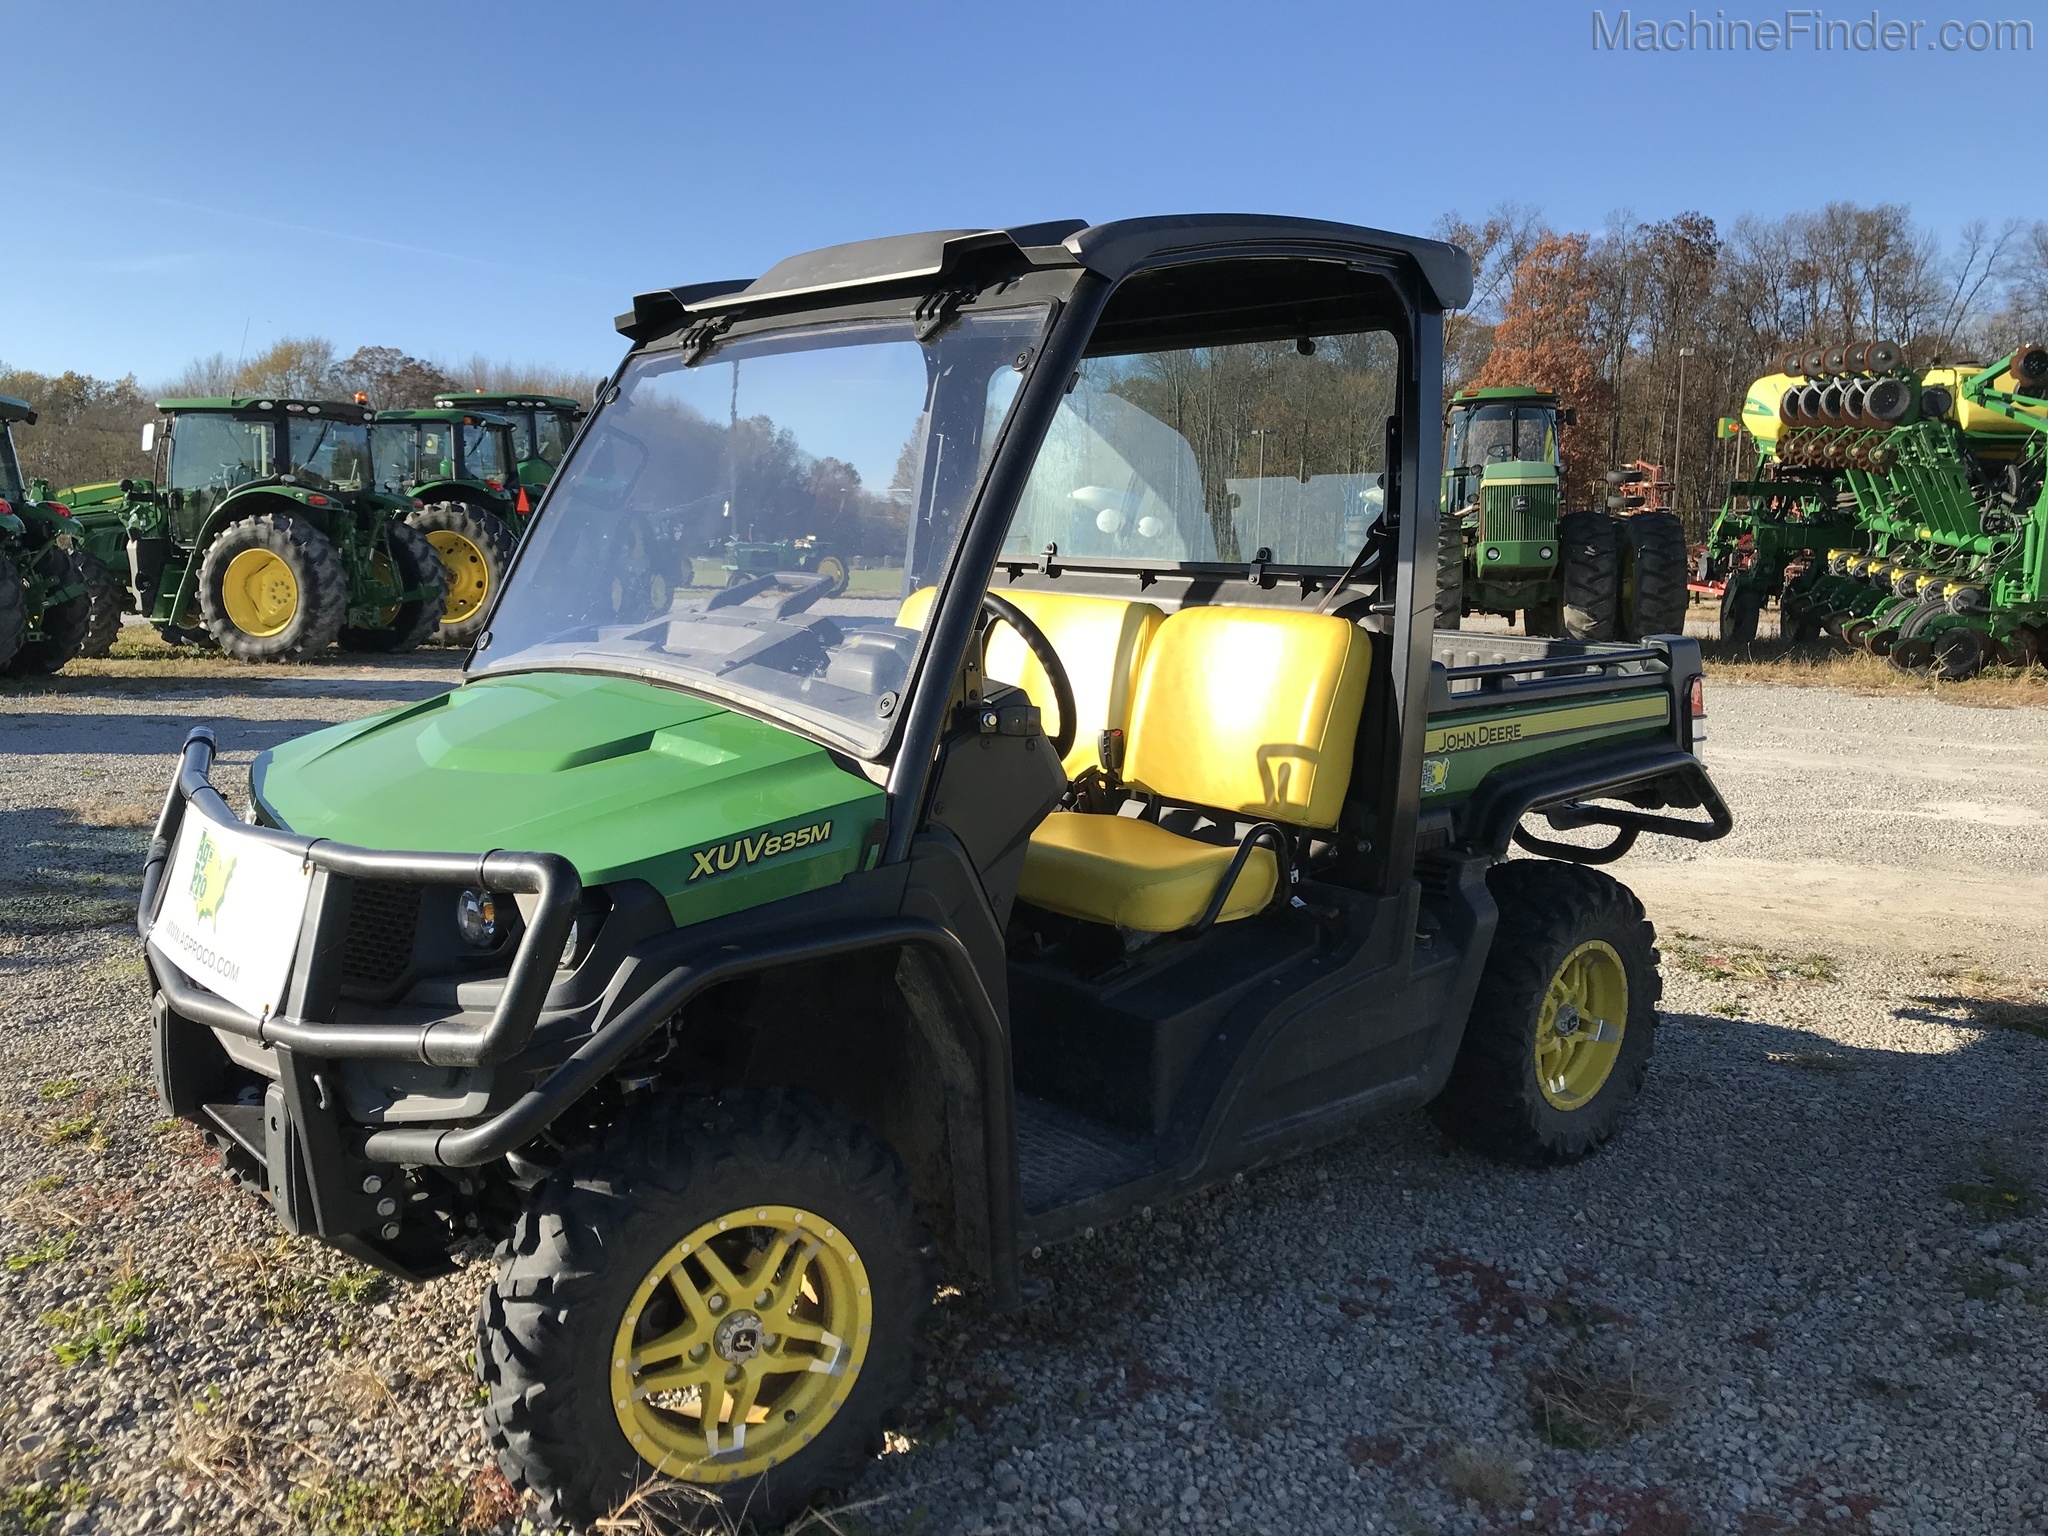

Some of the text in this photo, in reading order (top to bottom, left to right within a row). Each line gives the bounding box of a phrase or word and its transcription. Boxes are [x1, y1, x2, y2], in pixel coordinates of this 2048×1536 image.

[1438, 723, 1522, 751] JOHN DEERE
[688, 821, 832, 881] XUV835M
[189, 860, 208, 899] Pro
[165, 920, 240, 983] WWW.AGPROCO.COM
